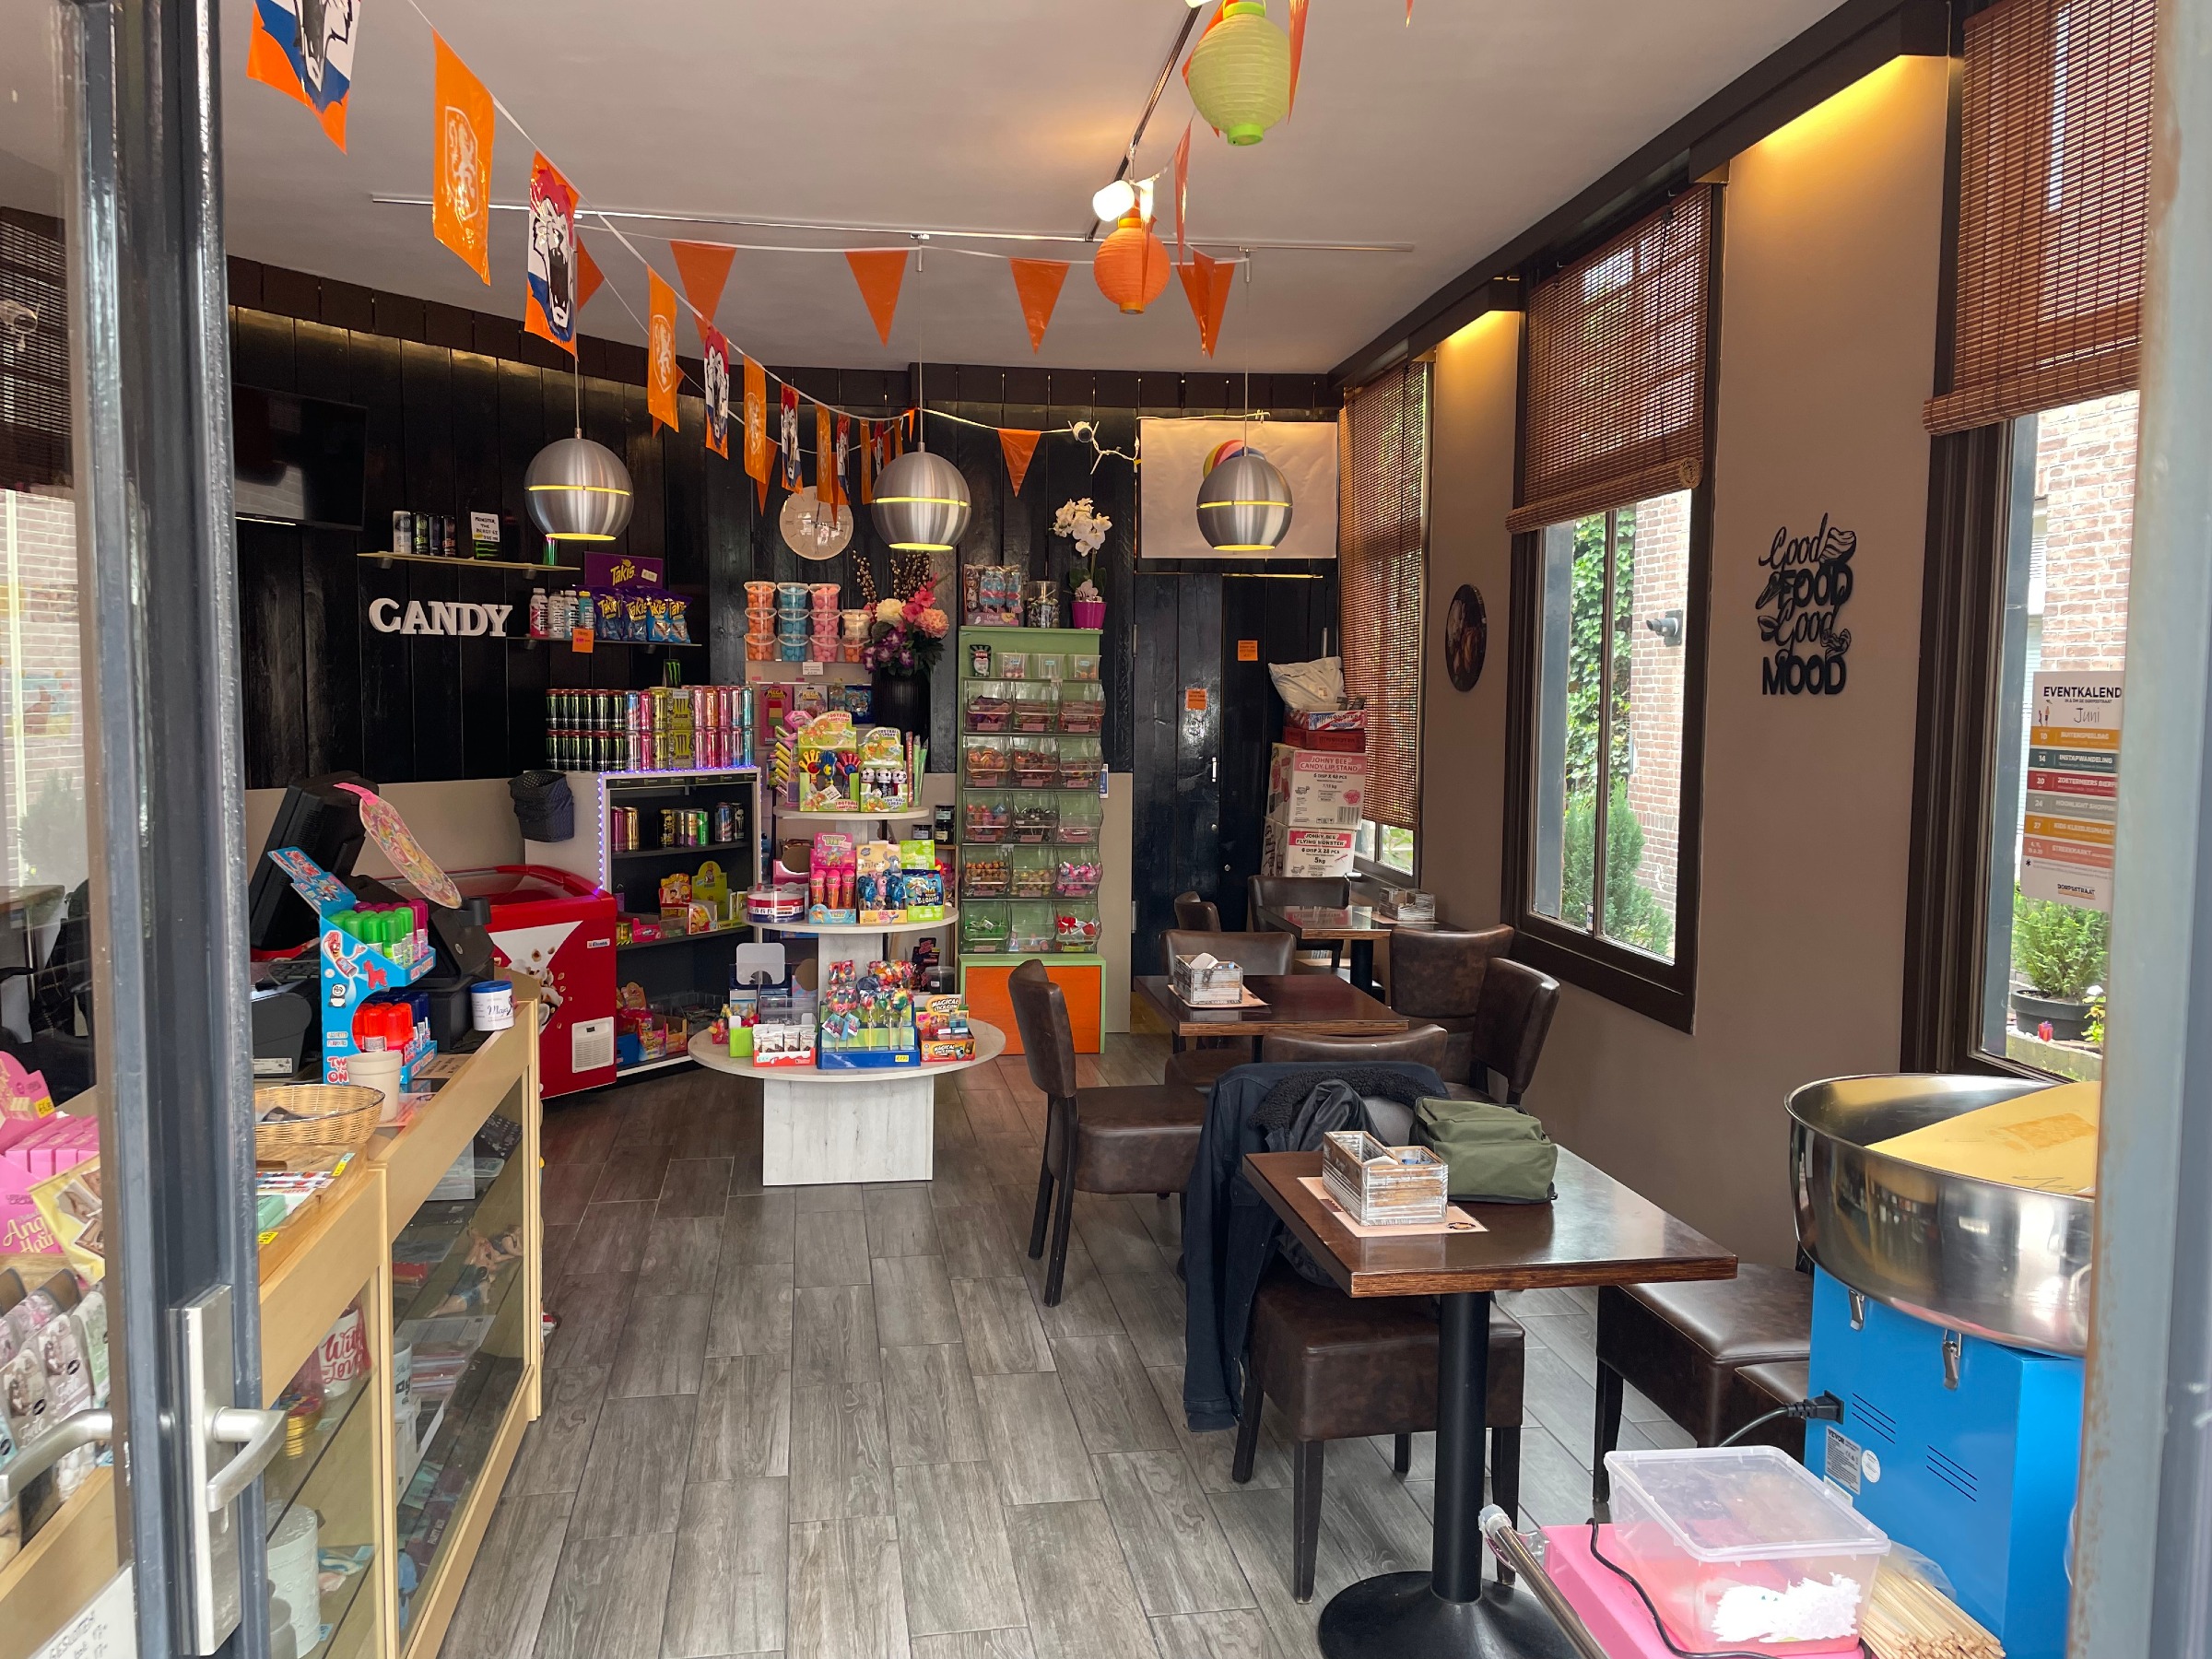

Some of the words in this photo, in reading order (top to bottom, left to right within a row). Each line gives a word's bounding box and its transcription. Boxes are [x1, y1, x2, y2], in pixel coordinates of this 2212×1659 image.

[610, 565, 636, 586] Takis
[1778, 562, 1853, 610] FOOD
[369, 597, 513, 637] CANDY
[1762, 653, 1847, 695] MOOD
[2043, 686, 2122, 698] EVENTKALEND
[2074, 707, 2100, 723] Juni
[2059, 754, 2113, 764] INSTAPWANDELING
[932, 998, 959, 1007] MAGICAL
